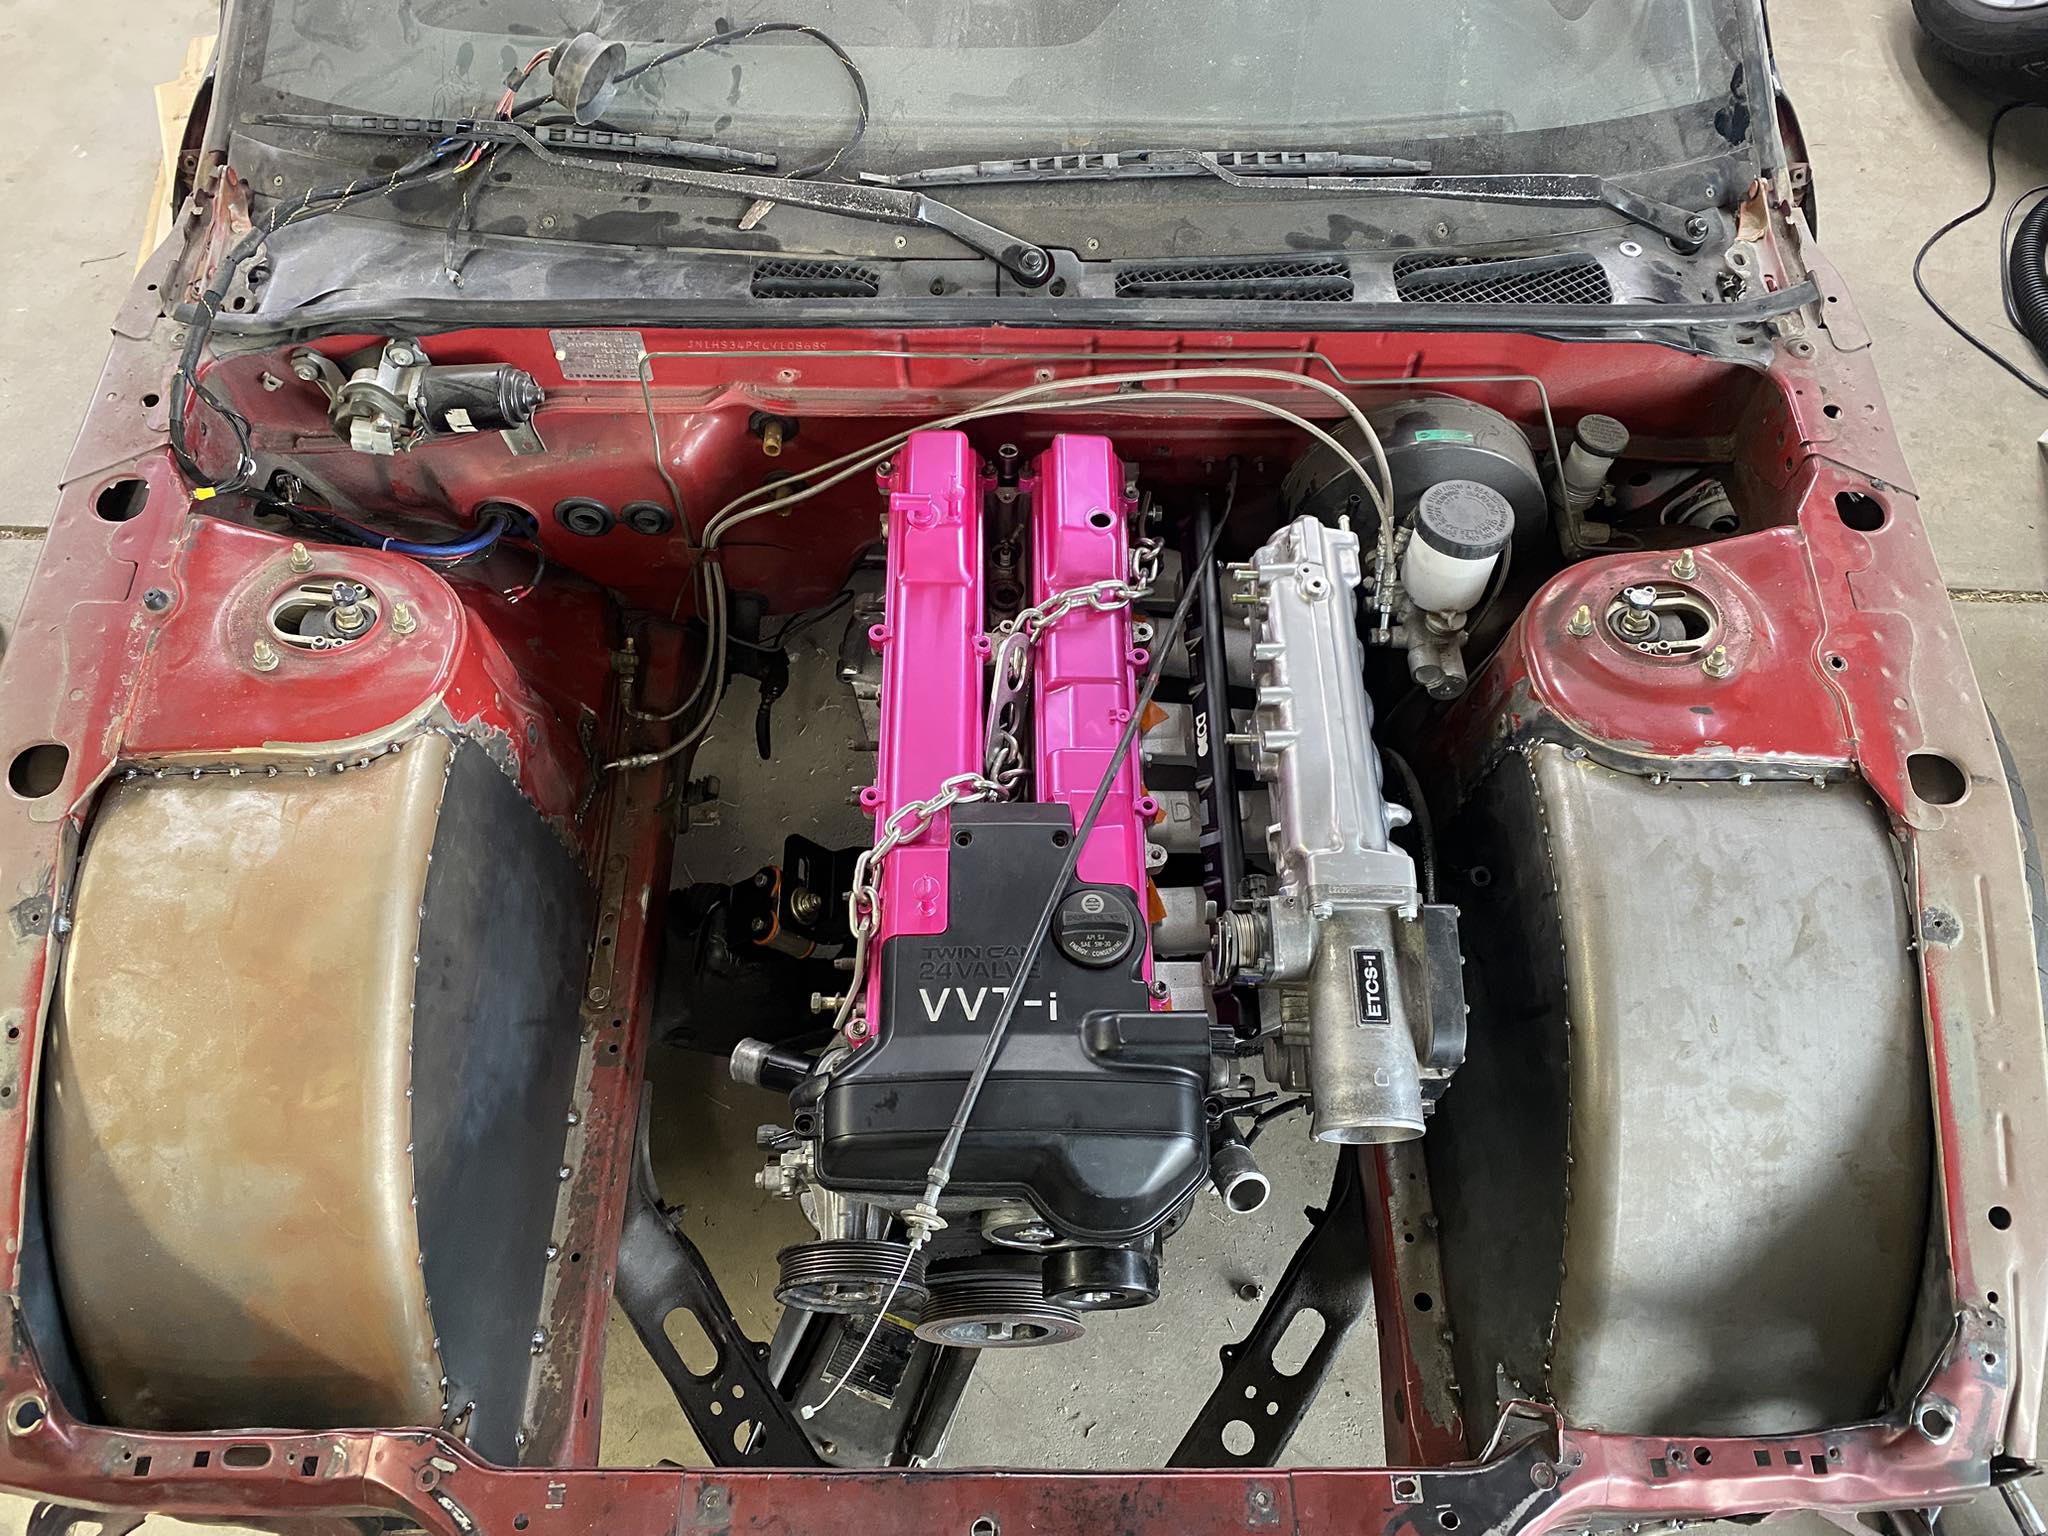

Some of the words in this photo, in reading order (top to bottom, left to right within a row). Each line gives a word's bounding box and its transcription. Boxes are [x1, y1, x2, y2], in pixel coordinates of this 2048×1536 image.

[921, 945, 982, 960] TWIN
[1069, 941, 1088, 956] ENERGY
[1092, 940, 1122, 957] CONSERVING
